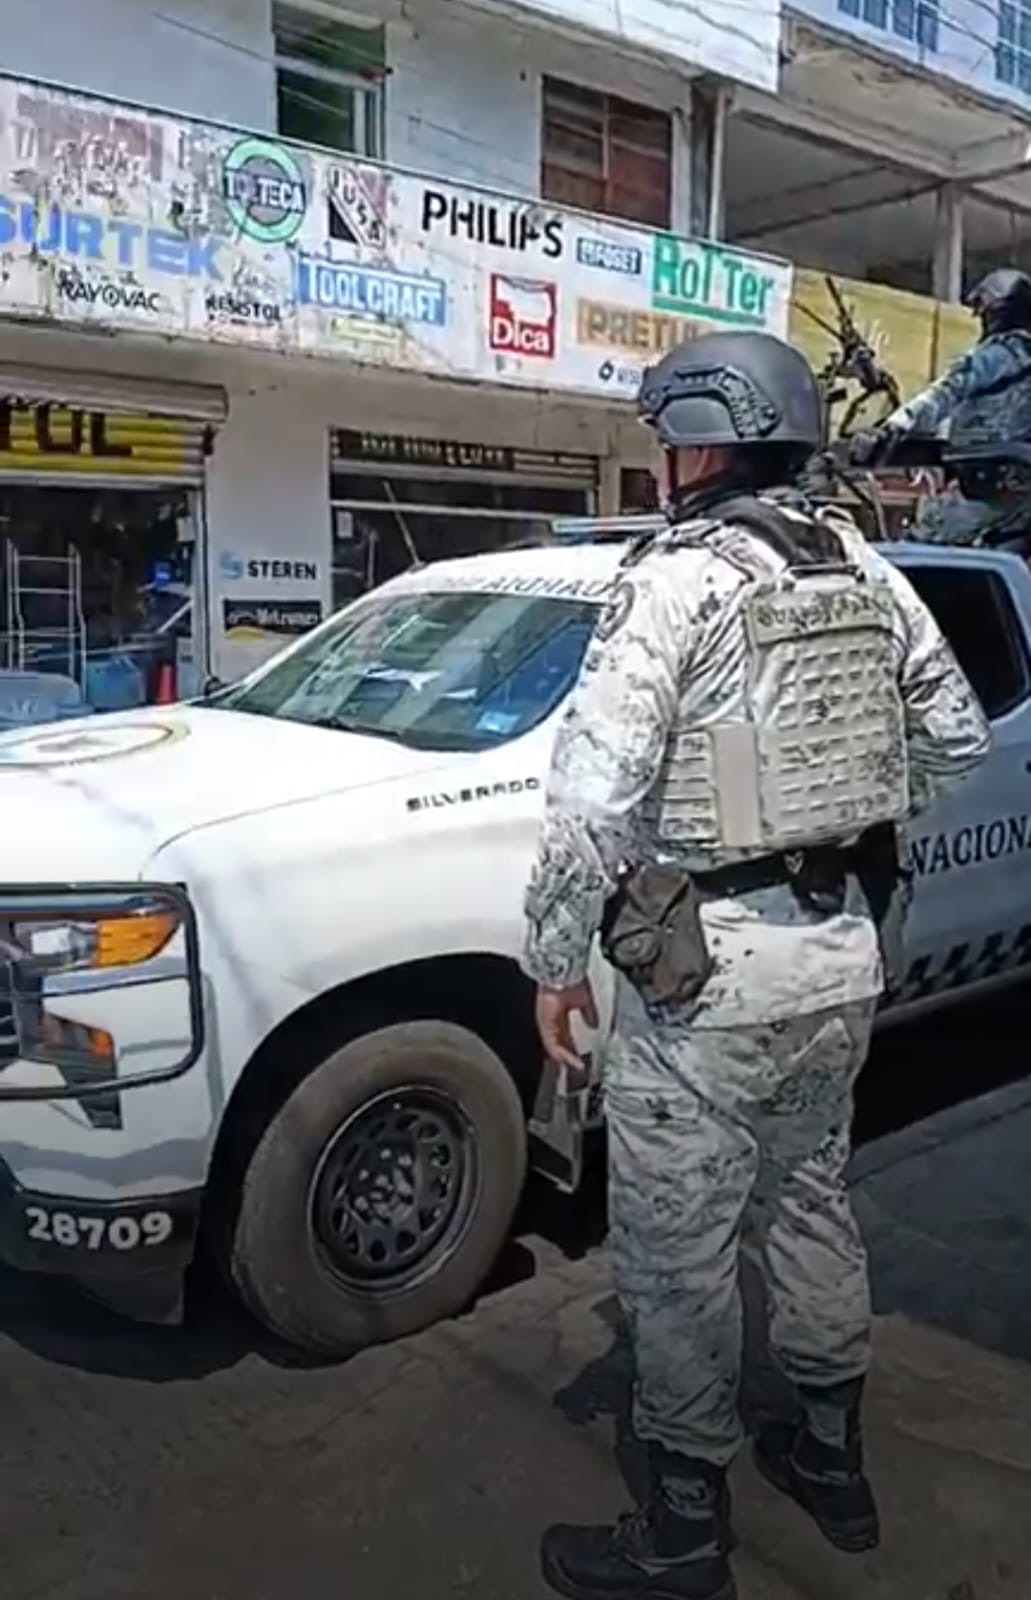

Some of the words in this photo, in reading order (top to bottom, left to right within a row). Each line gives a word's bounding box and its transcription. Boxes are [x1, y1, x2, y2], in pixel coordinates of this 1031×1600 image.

[59, 279, 160, 312] RAYOVAC
[307, 261, 442, 322] TOOLCRAFT
[492, 314, 549, 351] Dica
[248, 559, 317, 580] STEREN
[406, 777, 540, 811] SILVERADO
[911, 814, 1031, 876] NACION
[25, 1206, 173, 1250] 28709
